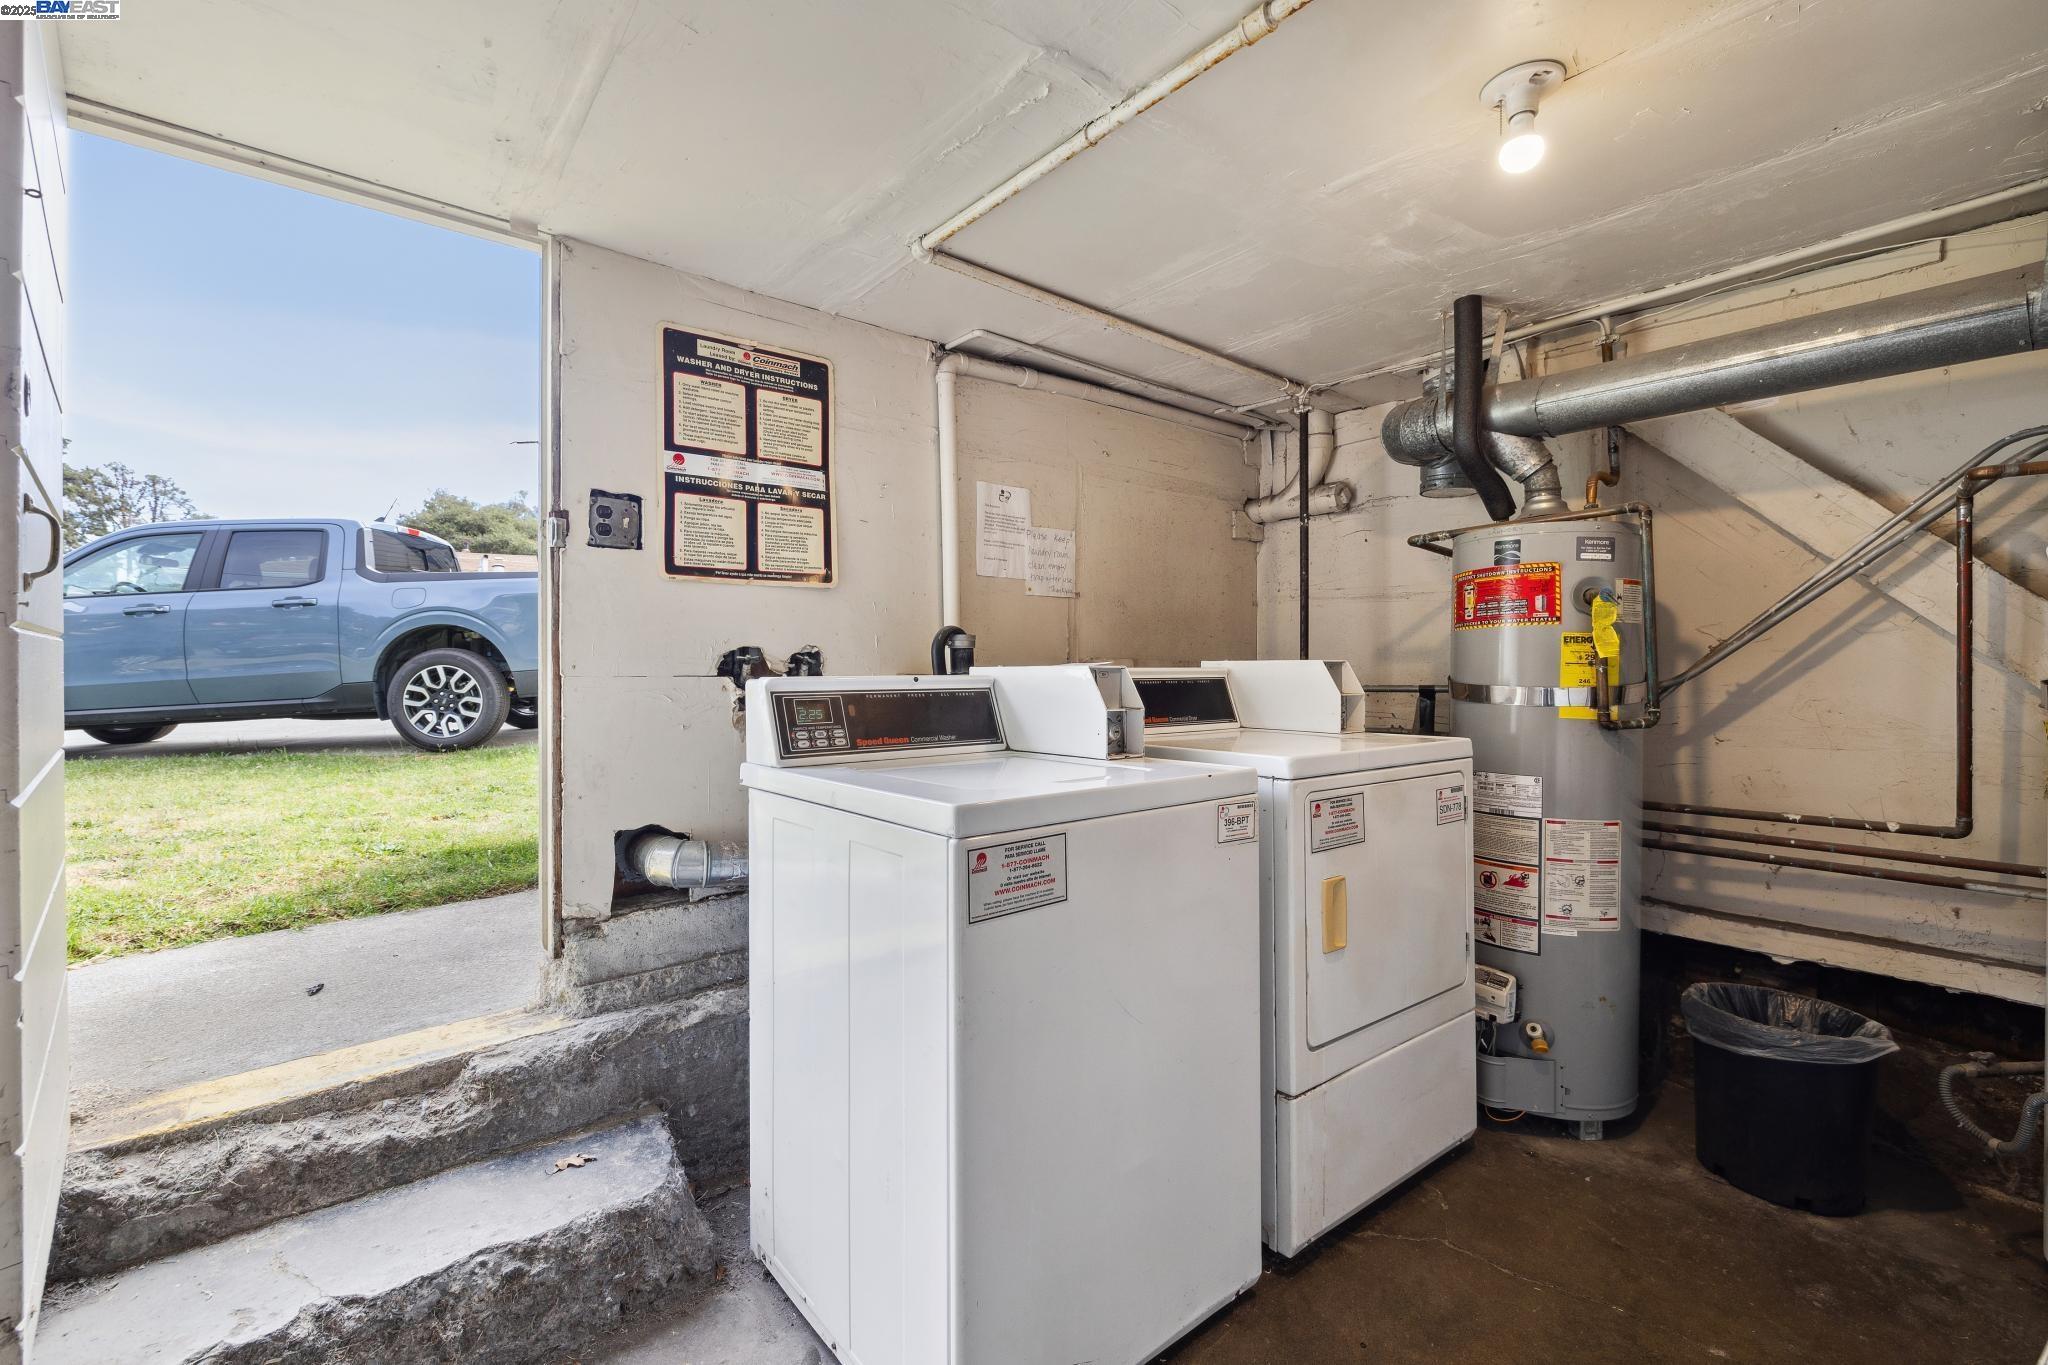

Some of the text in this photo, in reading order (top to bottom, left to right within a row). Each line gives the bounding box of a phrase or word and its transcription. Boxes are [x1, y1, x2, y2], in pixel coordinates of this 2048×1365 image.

[700, 343, 720, 352] Laundry
[752, 356, 799, 371] Coinmach
[676, 355, 713, 369] WASHER
[714, 363, 733, 373] AND
[734, 367, 760, 379] DRYER
[761, 374, 819, 390] INSTRUCTIONS
[675, 476, 743, 490] INSTRUCCIONES
[745, 485, 766, 493] PARA
[802, 492, 826, 500] SECAR
[1476, 571, 1505, 579] SHUTDOWN
[1506, 567, 1553, 575] INSTRUCTIONS
[856, 738, 883, 747] Speed
[884, 736, 909, 744] Queen
[1001, 854, 1050, 868] 1-877-COINMACH
[994, 878, 1056, 896] WWW.COINMACH.COM
